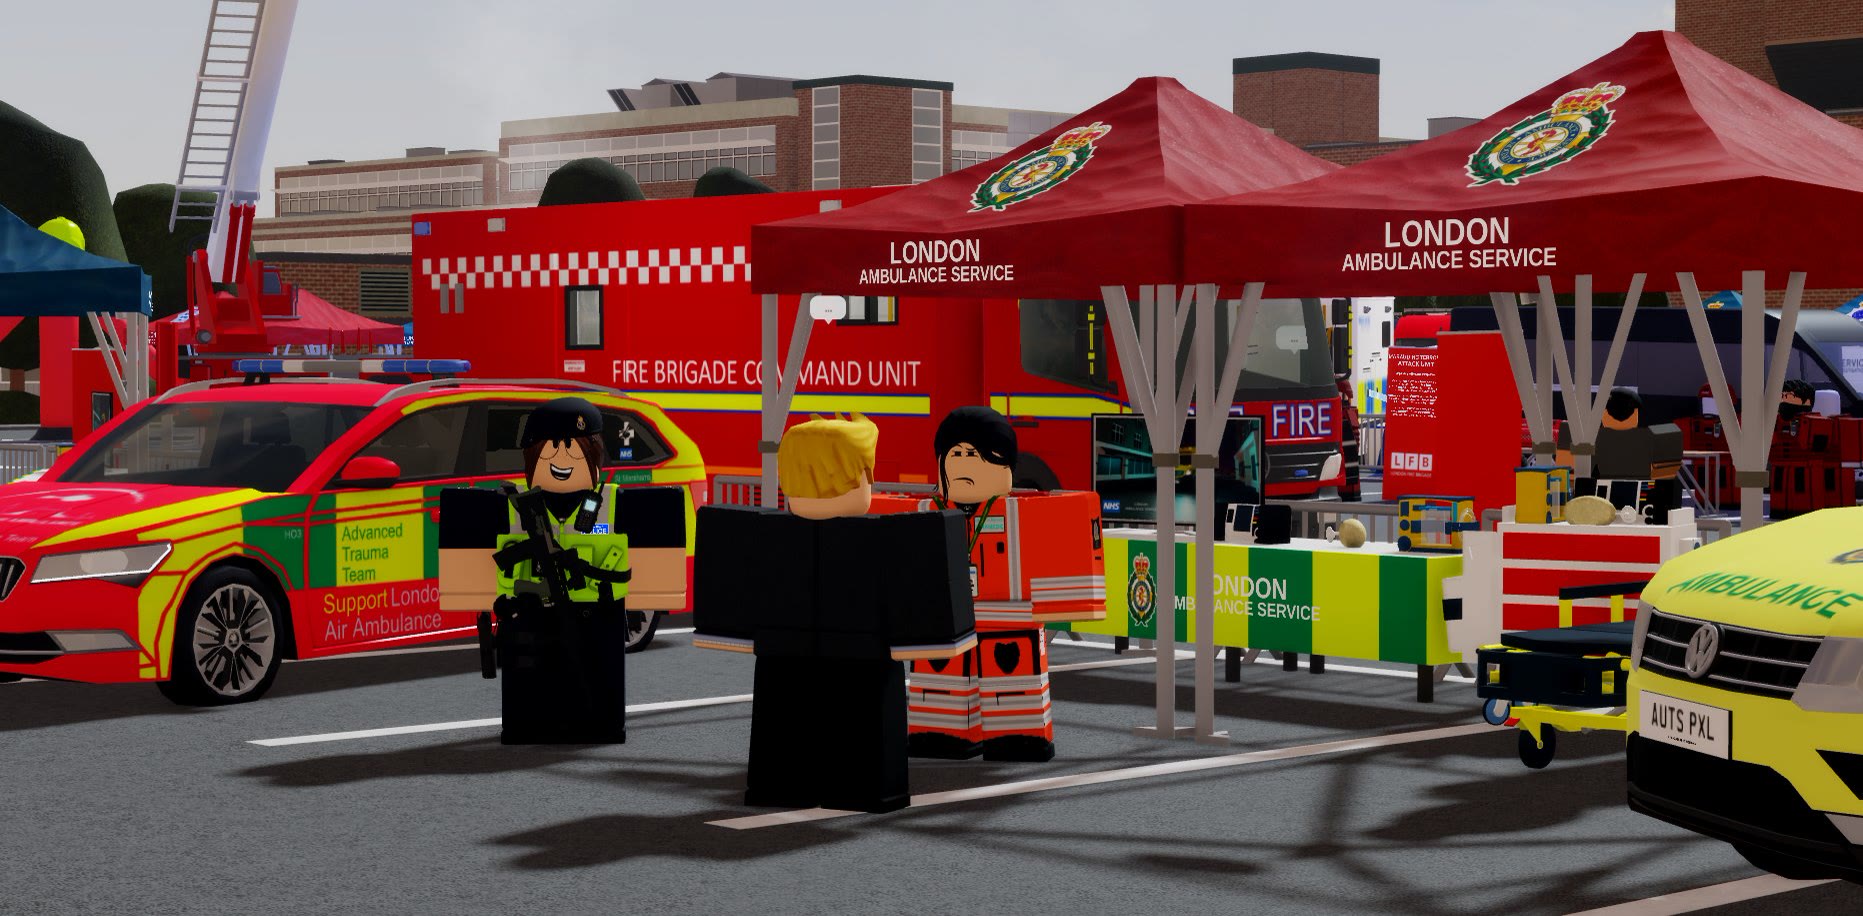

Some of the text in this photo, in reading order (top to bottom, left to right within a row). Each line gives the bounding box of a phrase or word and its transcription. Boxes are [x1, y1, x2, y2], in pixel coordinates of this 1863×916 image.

[1385, 216, 1509, 248] LONDON
[890, 238, 980, 265] LONDON
[1341, 247, 1557, 272] AMBULANCE SERVICE
[859, 264, 1014, 285] AMBULANCE SERVICE
[612, 359, 649, 384] FIRE
[654, 359, 737, 385] BRIGADE
[868, 360, 921, 387] UNIT
[1272, 402, 1332, 437] FIRE
[1103, 502, 1120, 511] NHS
[342, 522, 403, 541] Advanced
[342, 546, 389, 562] Trauma
[342, 567, 376, 583] Team
[1213, 573, 1287, 600] ONDON
[323, 584, 440, 617] Support Londo
[1667, 572, 1863, 619] AMBULANCE
[1257, 601, 1321, 621] SERVICE
[324, 612, 442, 641] Air Ambulance
[1651, 702, 1715, 741] AUTS PXL
